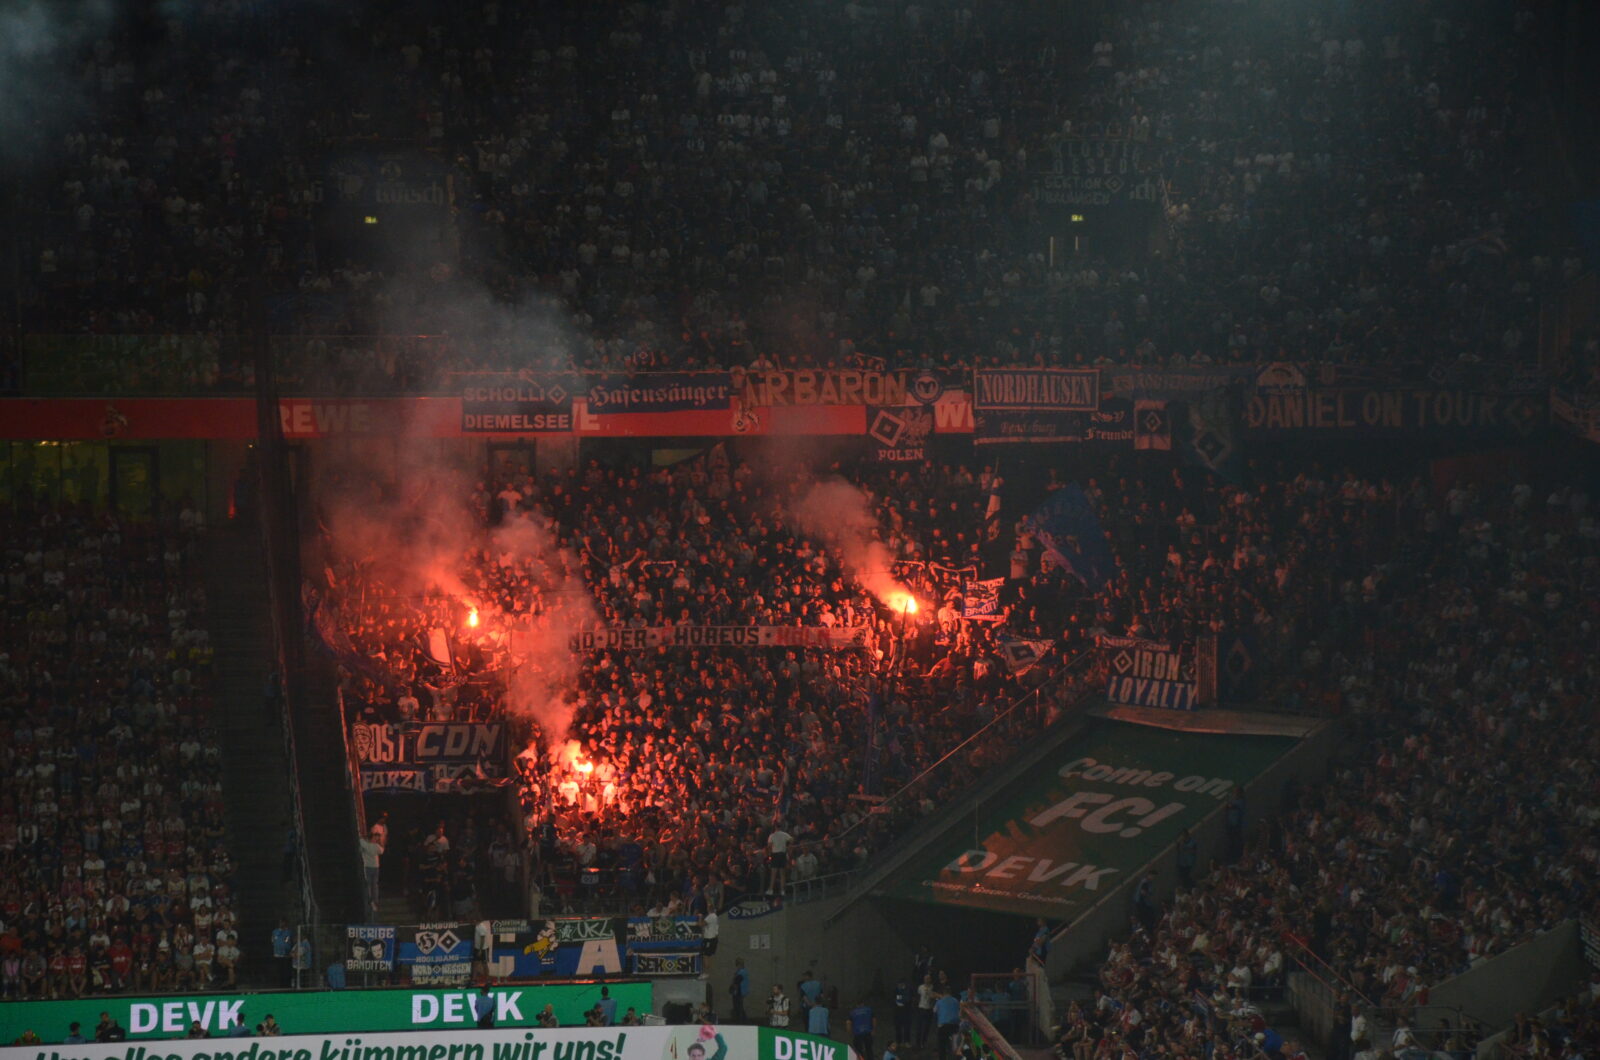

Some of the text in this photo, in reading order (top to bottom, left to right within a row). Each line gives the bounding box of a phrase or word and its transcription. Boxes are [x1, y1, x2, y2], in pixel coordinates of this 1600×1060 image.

[463, 387, 545, 402] SCHOLLI
[981, 374, 1092, 404] NORDHAUSEN
[465, 414, 569, 430] DIEMELSEE
[1247, 389, 1500, 429] DANIEL ON TOUR
[878, 449, 924, 461] POLEN
[1133, 650, 1181, 681] IRON
[1108, 675, 1200, 711] LOYALTY
[1058, 757, 1175, 787] Come
[1030, 791, 1187, 838] FC!
[940, 849, 1120, 891] DEVK
[346, 960, 392, 972] BANDITEN
[130, 999, 245, 1034] DEVK
[493, 1032, 547, 1060] wir
[553, 1032, 627, 1060] uns!
[774, 1036, 836, 1060] DEVK
